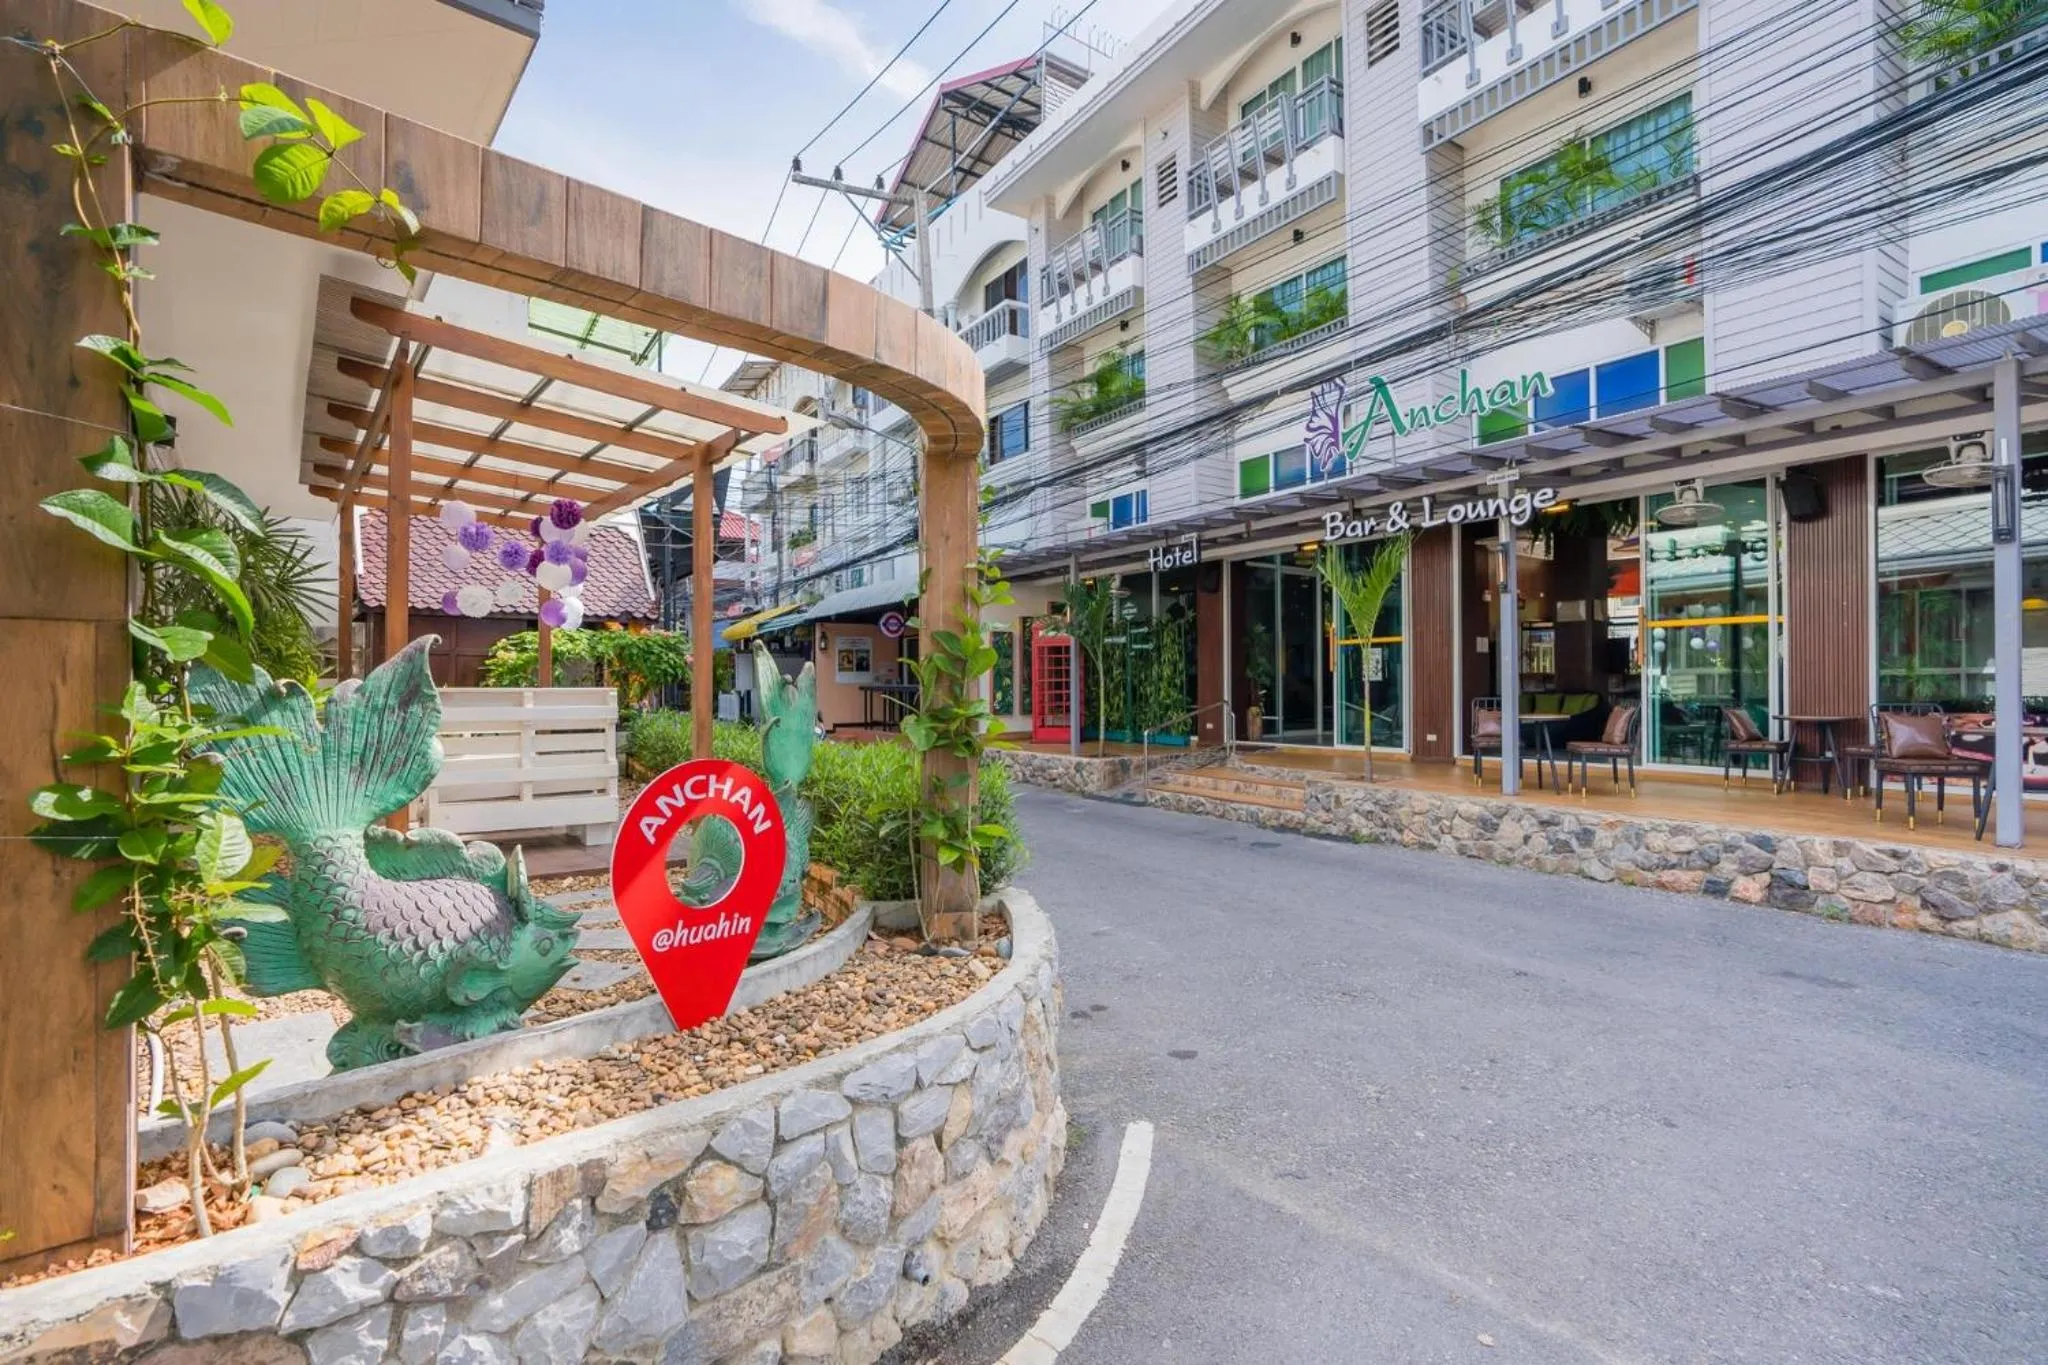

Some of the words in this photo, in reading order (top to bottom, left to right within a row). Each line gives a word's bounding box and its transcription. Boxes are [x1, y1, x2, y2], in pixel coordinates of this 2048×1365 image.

[1342, 368, 1554, 461] Anchan
[1321, 511, 1377, 541] Bar
[1386, 501, 1410, 532] &
[1421, 487, 1557, 525] Lounge
[1148, 536, 1197, 572] Hotel
[638, 774, 772, 845] ANCHAN
[652, 913, 752, 952] @huahin
